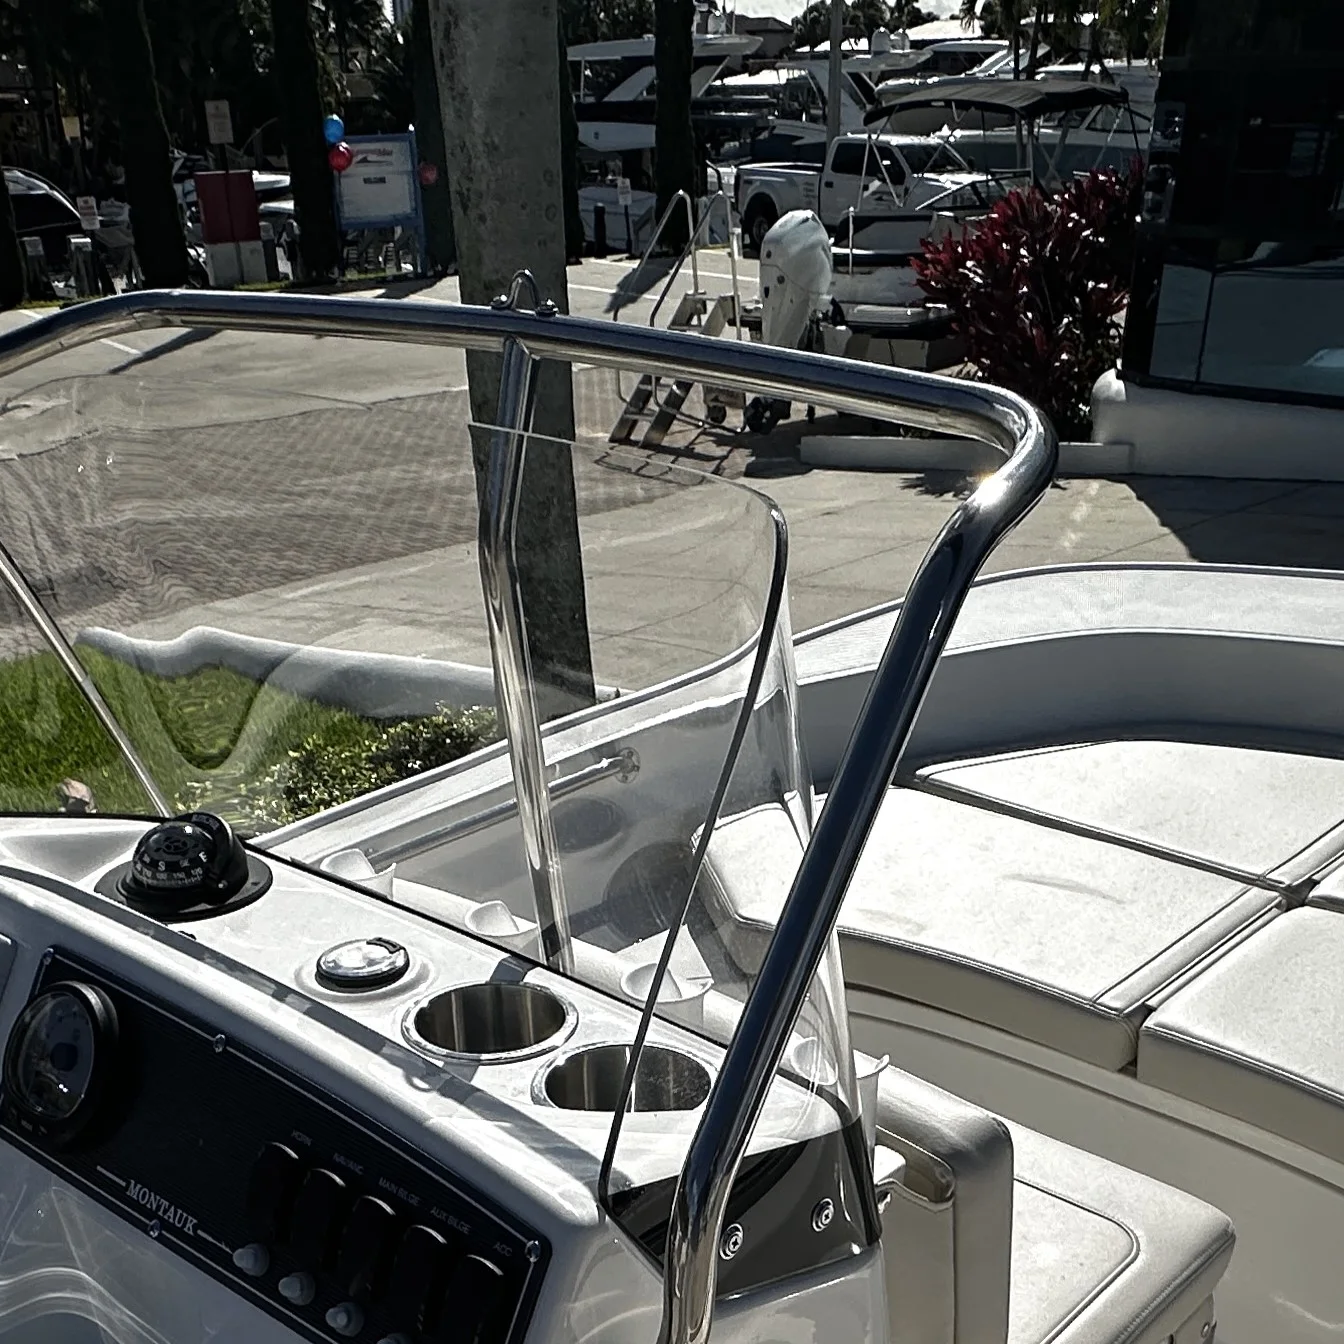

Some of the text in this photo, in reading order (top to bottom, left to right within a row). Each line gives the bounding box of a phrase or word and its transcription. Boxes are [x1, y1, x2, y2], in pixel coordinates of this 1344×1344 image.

[198, 851, 208, 863] E
[377, 1176, 422, 1207] MAIN BILGE
[126, 1179, 198, 1236] MONTAUK
[429, 1205, 472, 1235] AUX BILGE
[492, 1241, 513, 1257] ACC
